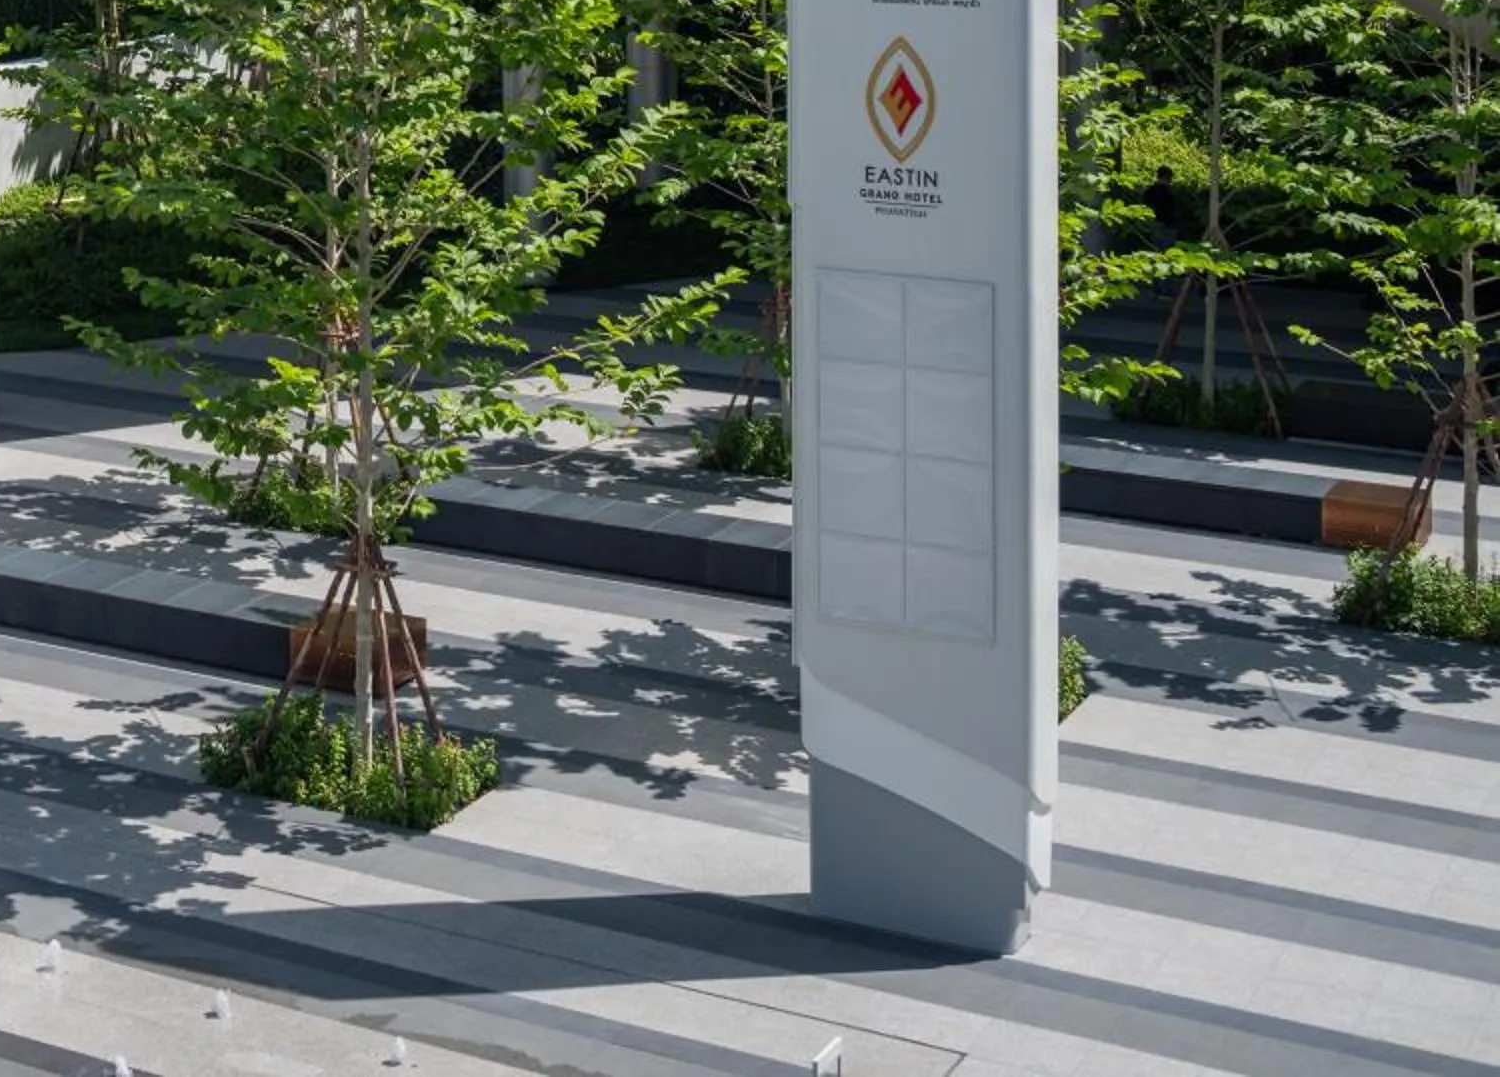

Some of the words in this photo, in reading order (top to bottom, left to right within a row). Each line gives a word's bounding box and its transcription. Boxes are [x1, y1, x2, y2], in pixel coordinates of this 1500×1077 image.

[864, 165, 938, 188] EASTIN
[859, 188, 899, 200] GRAND
[904, 191, 944, 204] HOTEL
